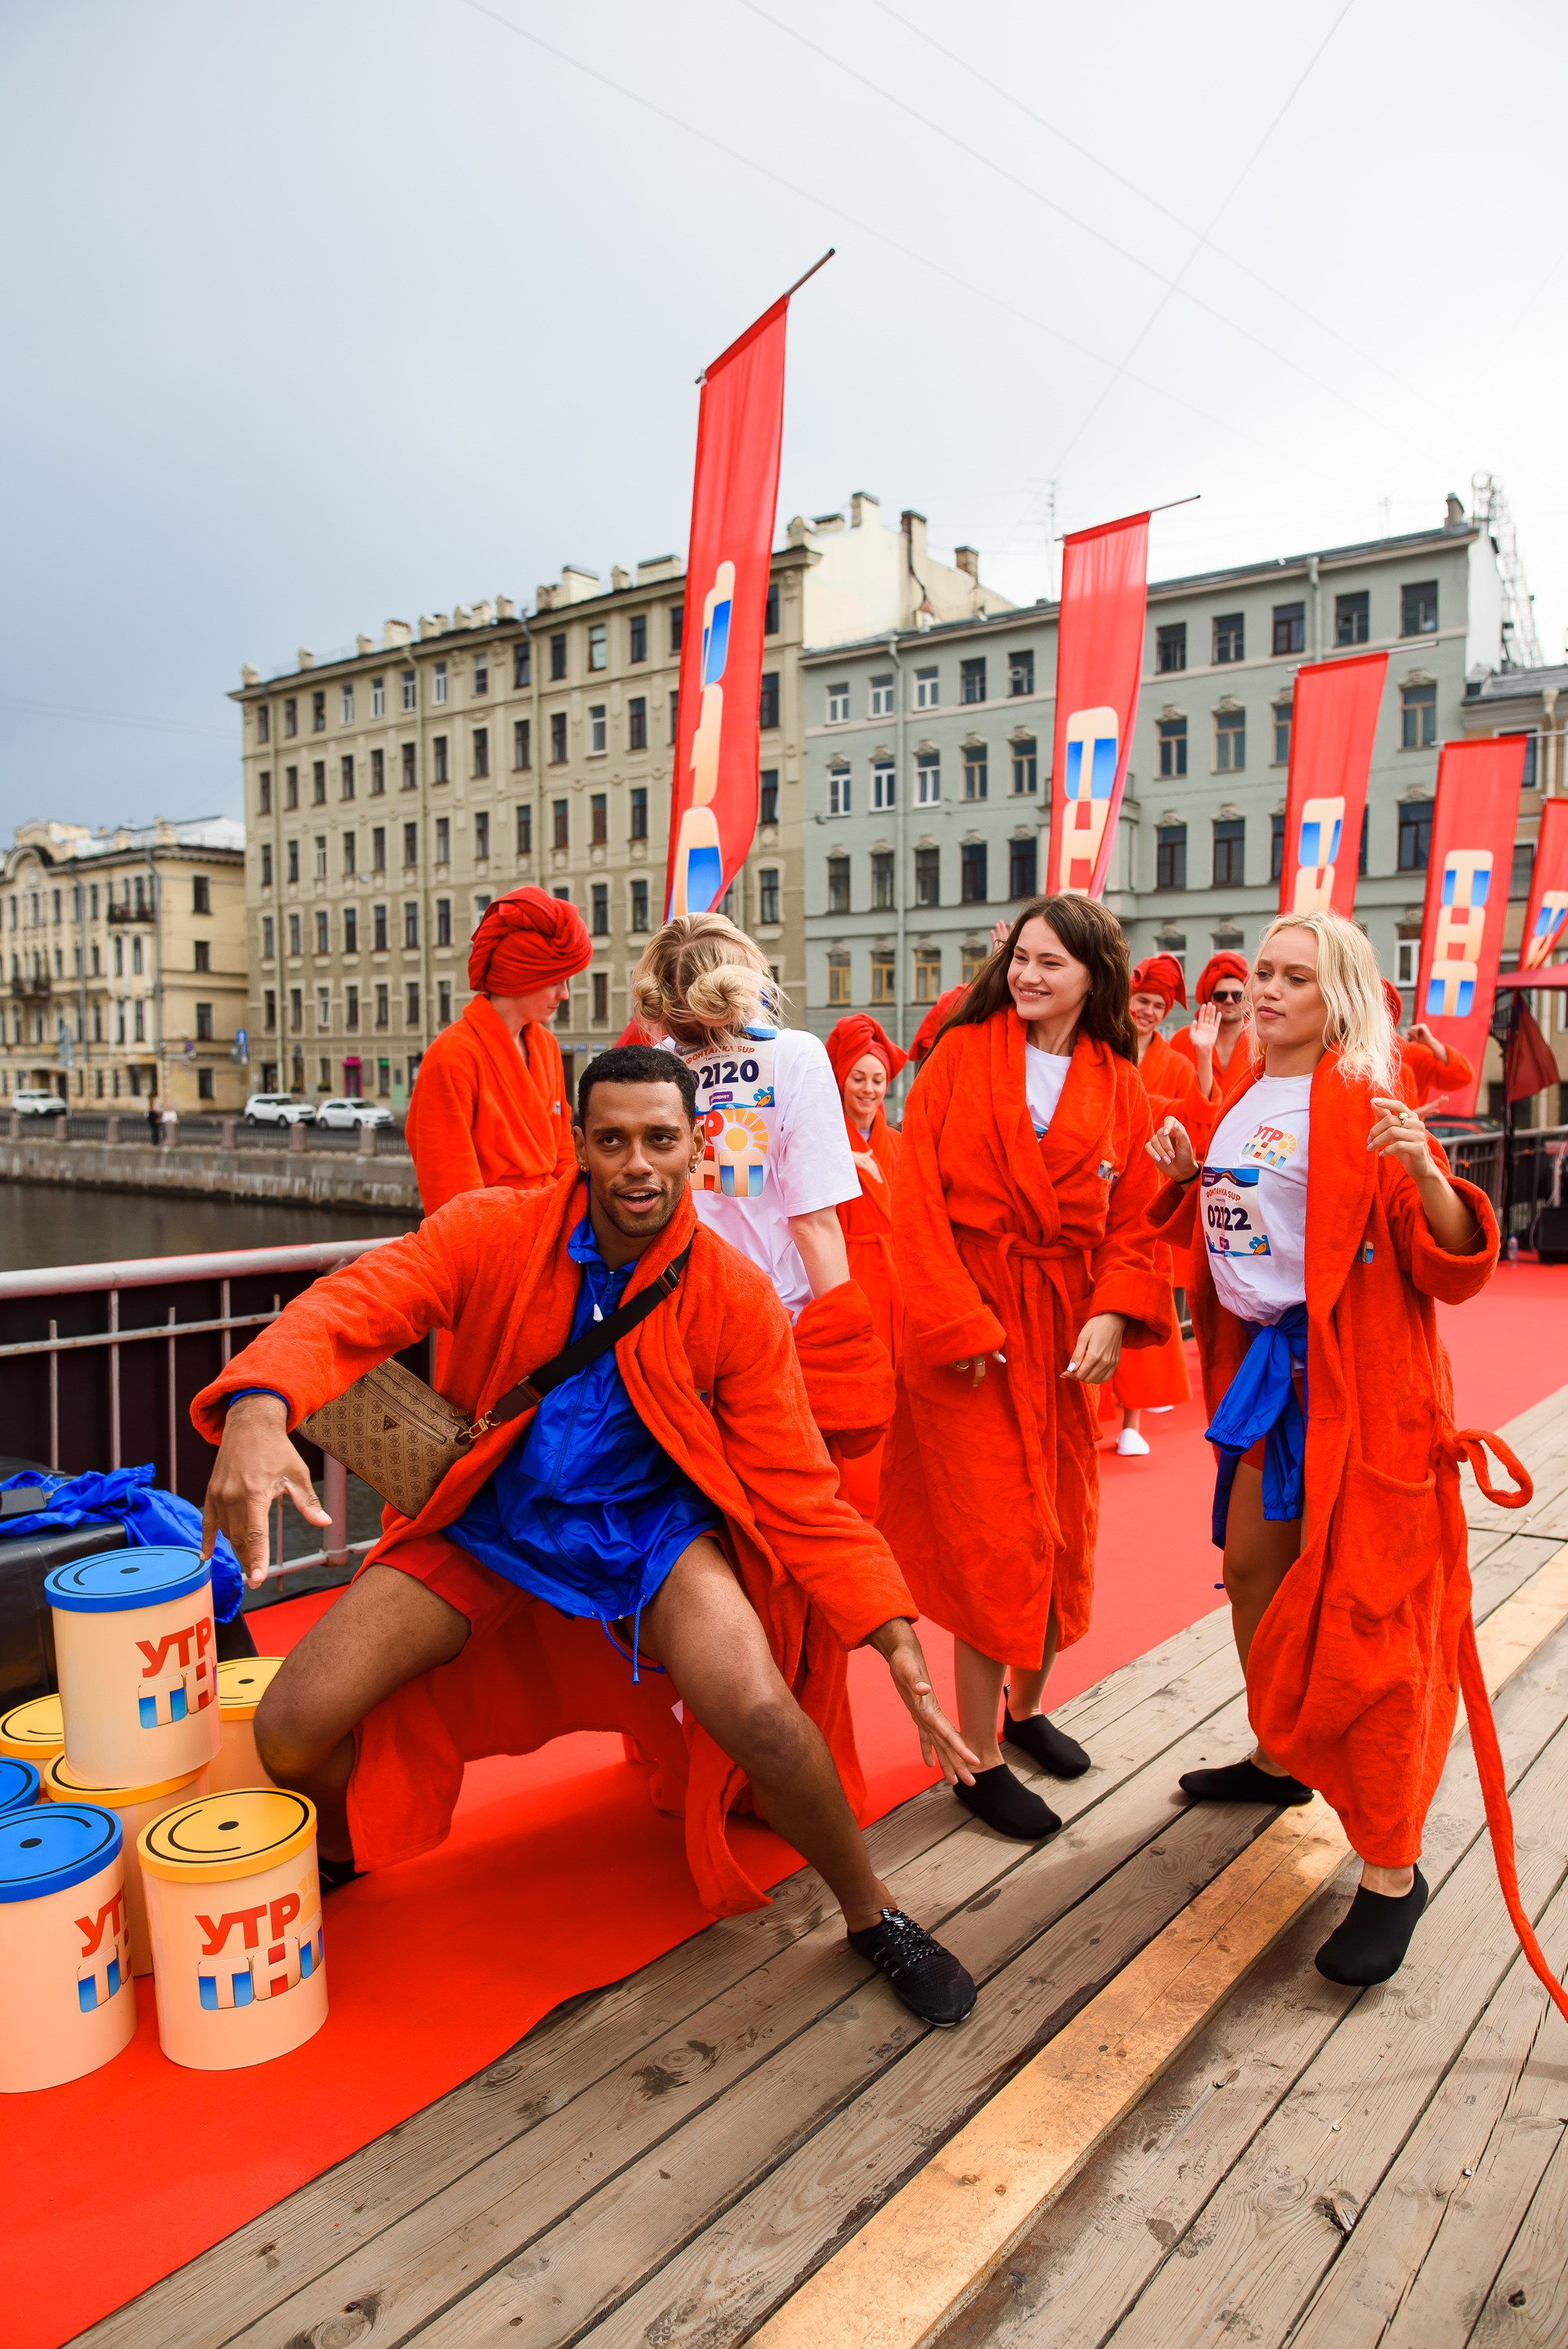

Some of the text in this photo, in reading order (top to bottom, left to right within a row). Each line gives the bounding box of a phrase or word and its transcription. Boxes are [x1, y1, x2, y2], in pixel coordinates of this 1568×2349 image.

[1426, 850, 1494, 1017] ТНТ
[737, 1045, 755, 1054] SUP
[1206, 1187, 1227, 1199] ФОНТАНКА
[1227, 1190, 1242, 1202] SUP
[138, 1656, 217, 1729] ТН
[74, 1883, 128, 1958] УТ
[198, 1921, 324, 2011] ТНТ
